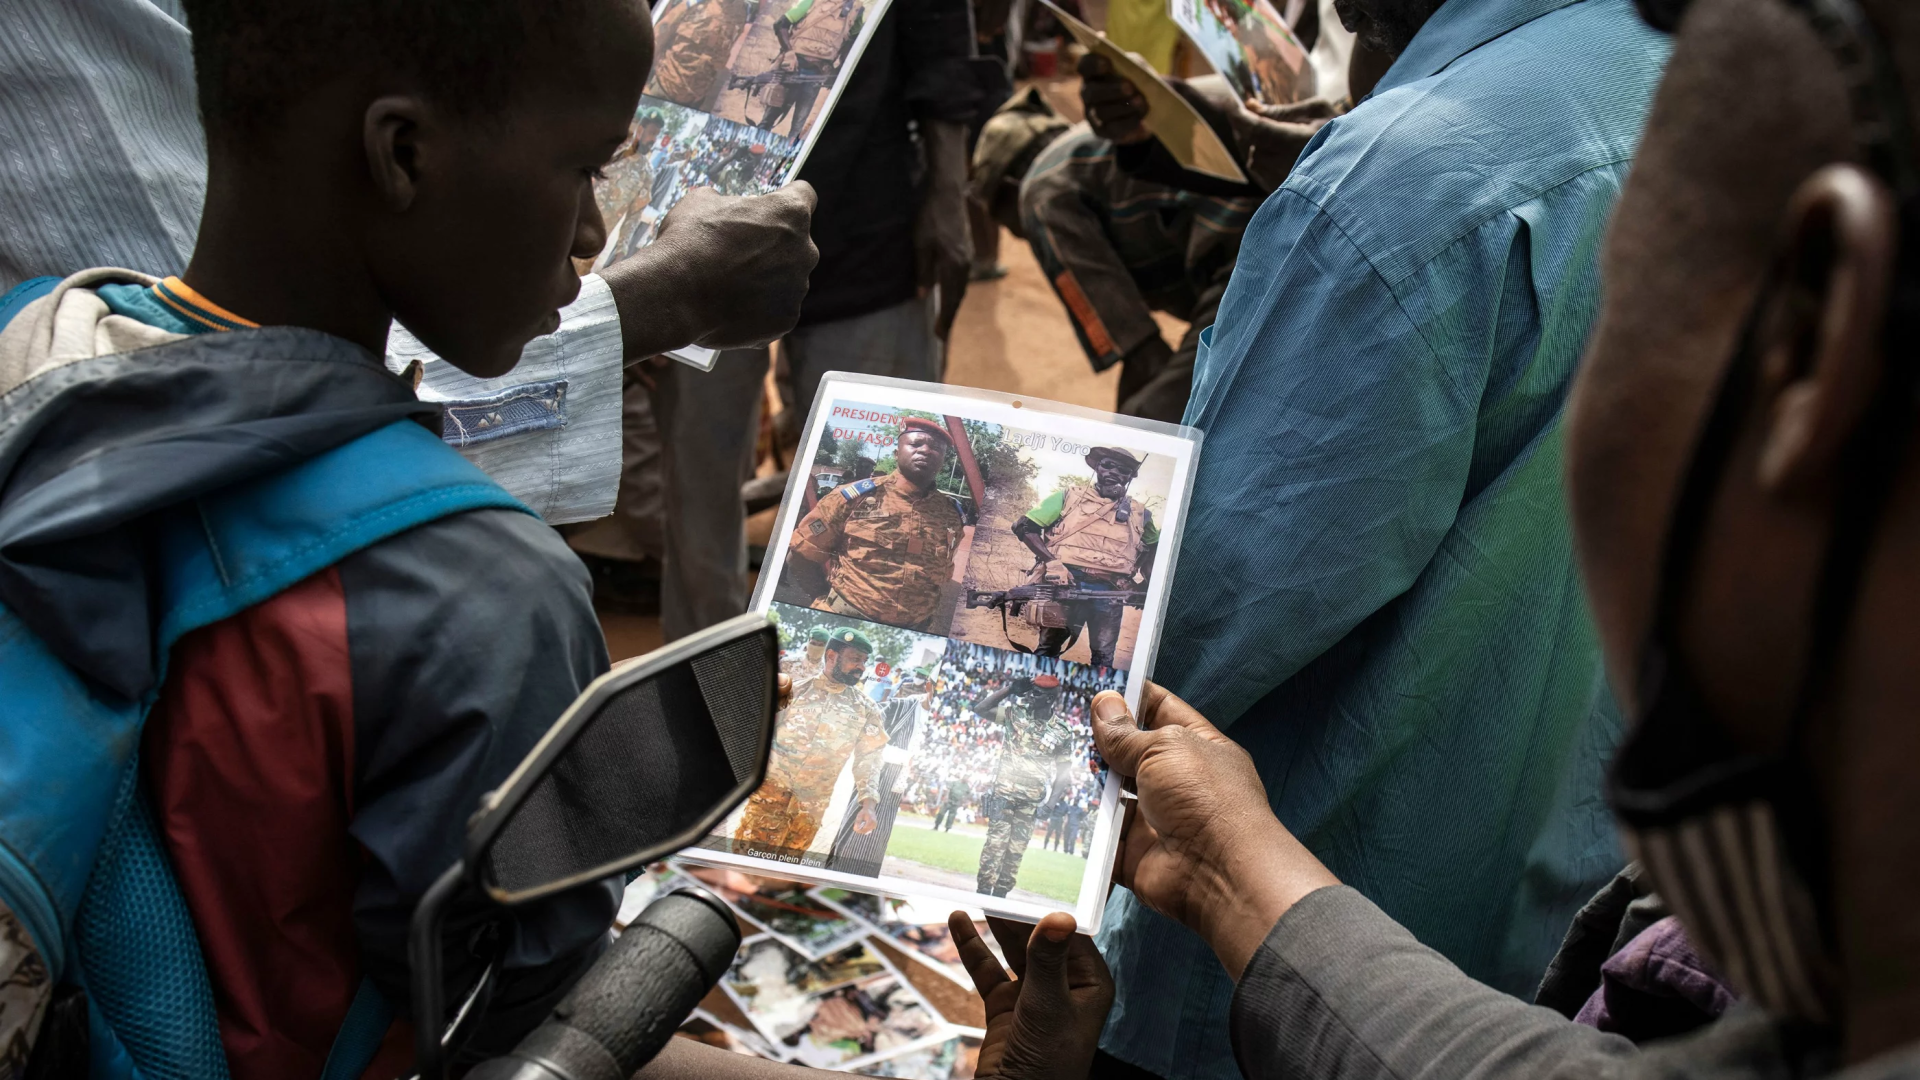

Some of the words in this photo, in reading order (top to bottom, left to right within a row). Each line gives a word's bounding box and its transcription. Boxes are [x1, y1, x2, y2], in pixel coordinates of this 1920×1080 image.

[832, 406, 906, 426] PRESIDENT
[832, 428, 854, 440] DU
[857, 431, 893, 447] FASO
[1003, 428, 1046, 451] Ladji
[1051, 436, 1091, 456] Yoro
[747, 848, 777, 859] Garçon
[778, 854, 799, 863] plein
[800, 858, 821, 867] plein
